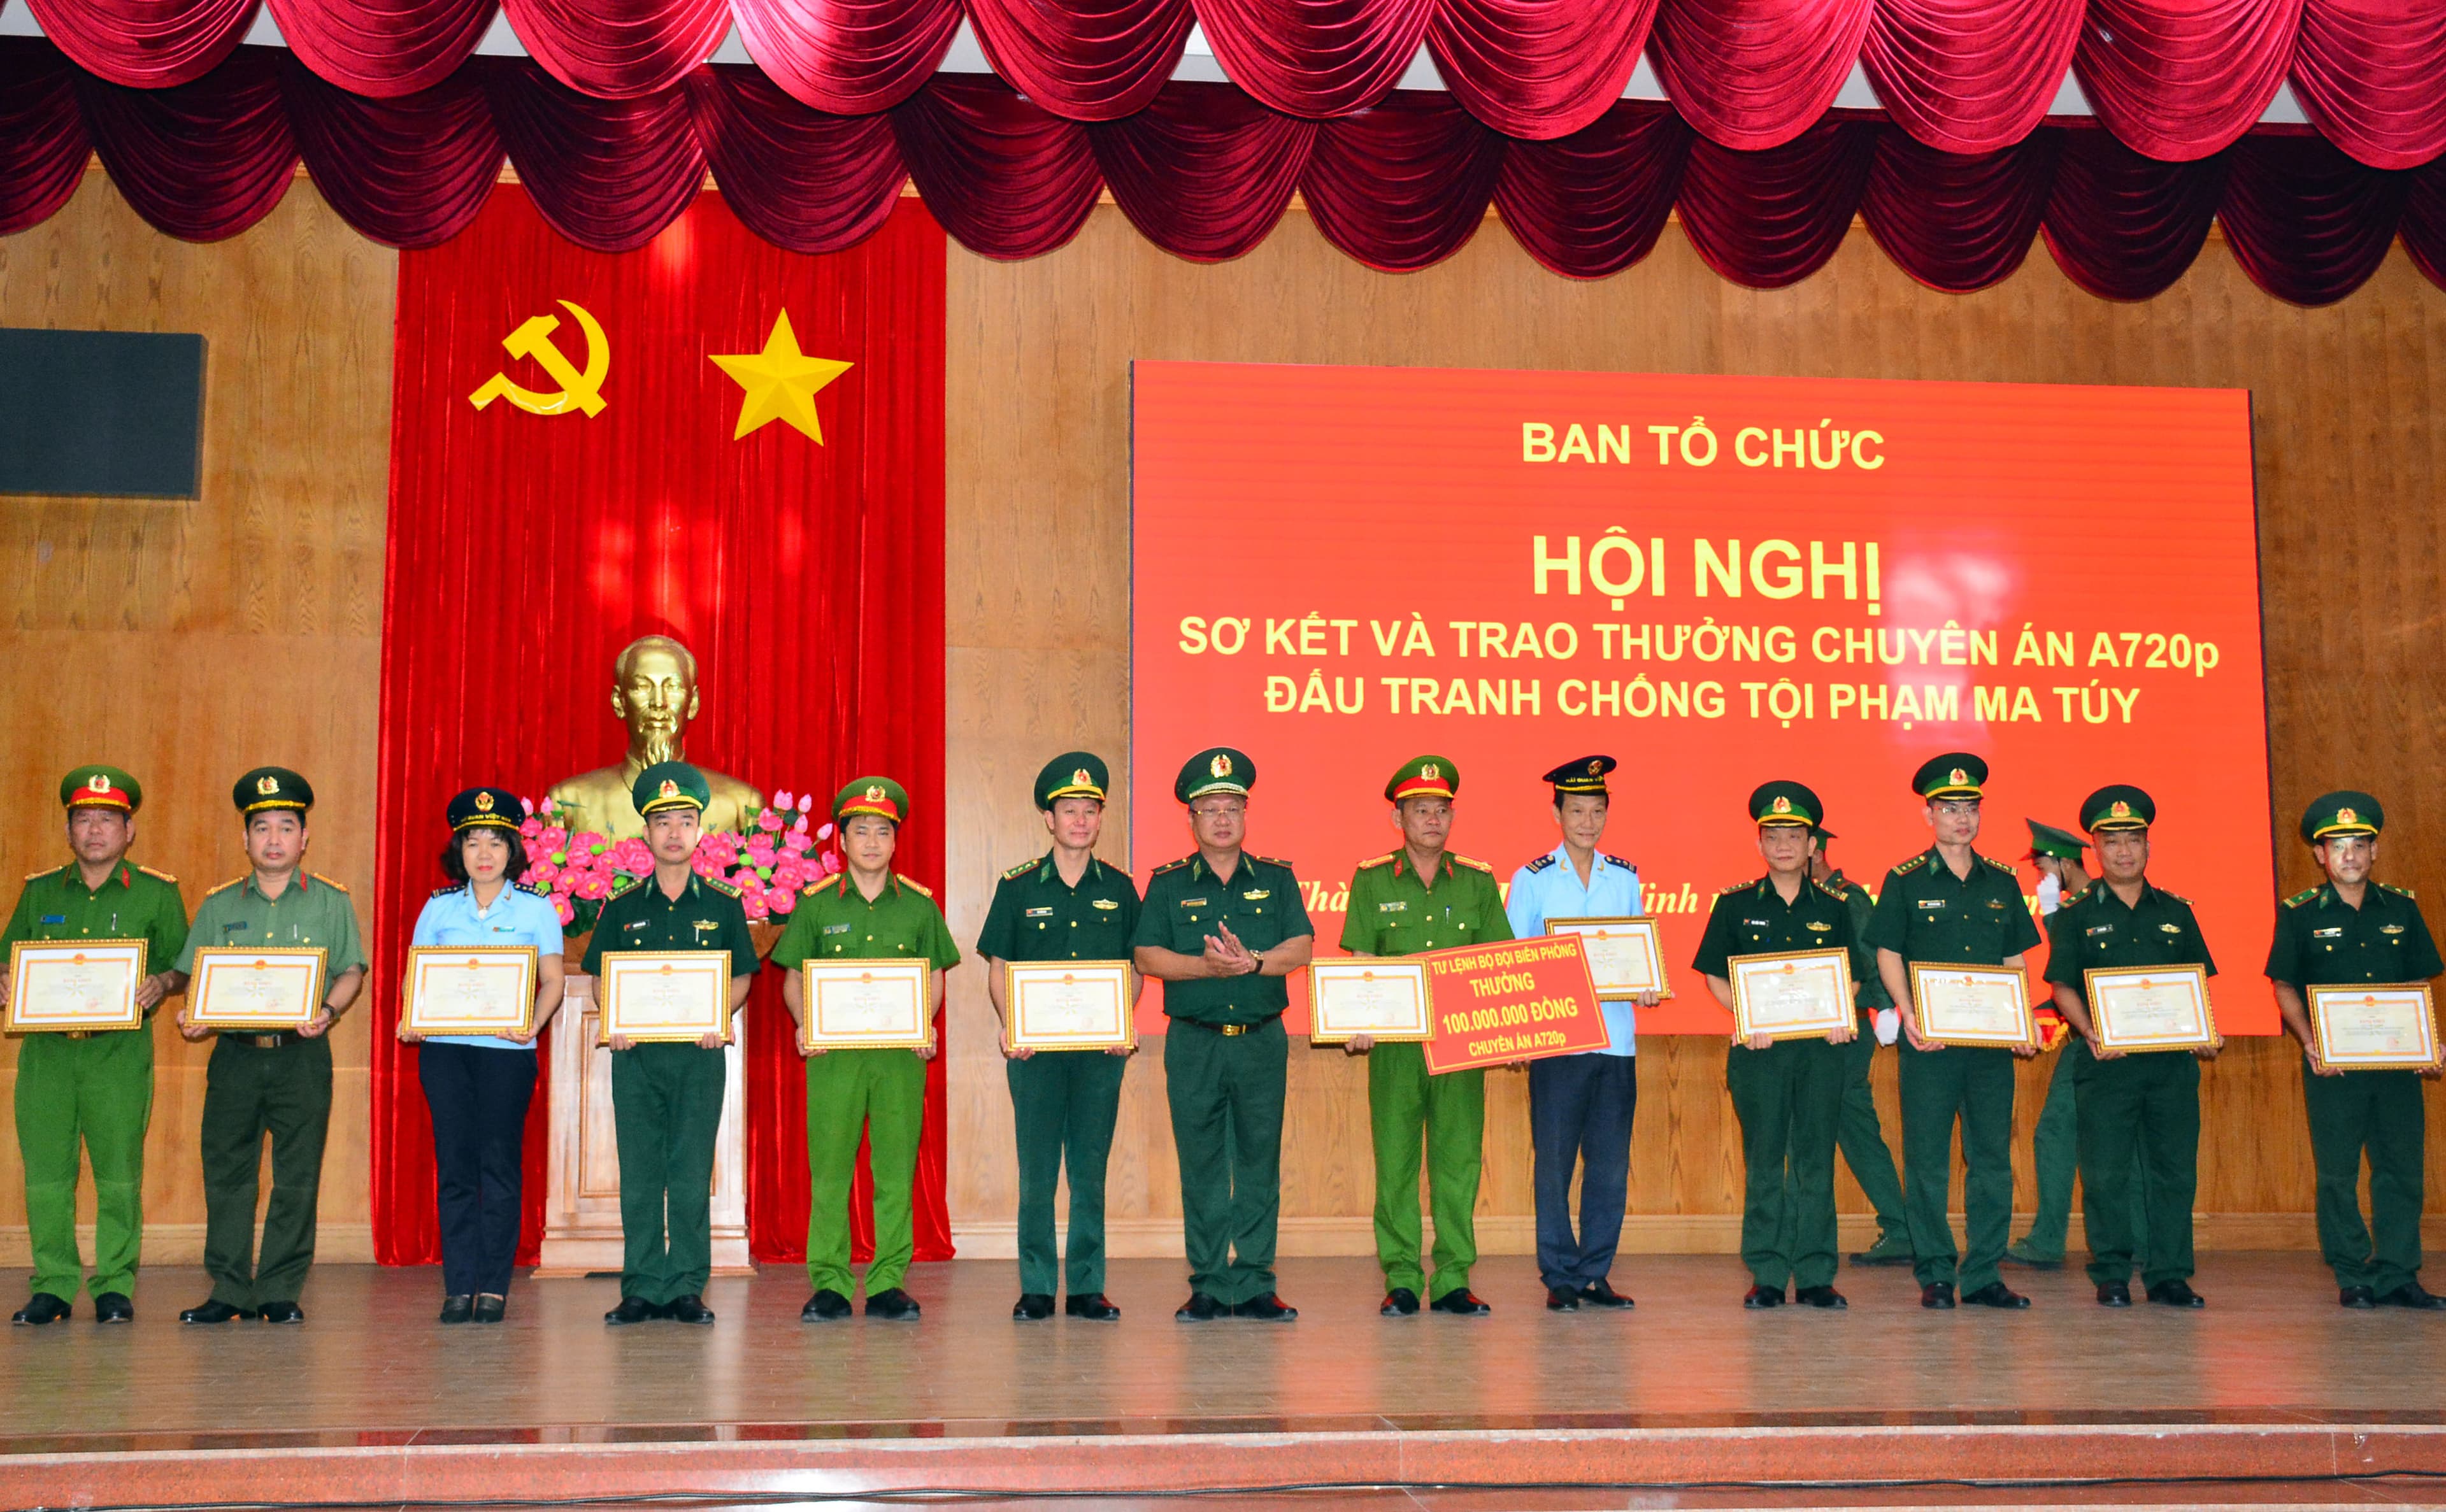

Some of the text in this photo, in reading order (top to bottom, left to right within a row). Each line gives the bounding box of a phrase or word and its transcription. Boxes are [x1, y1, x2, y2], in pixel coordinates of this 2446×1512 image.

[1522, 415, 1885, 470] BAN TỔ CHỨC
[1533, 525, 1881, 616] HỘI NGHỊ
[1179, 611, 2219, 678] SƠ KẾT VÀ TRAO THƯỞNG CHUYÊN ÁN A720p
[1263, 668, 2140, 731] ĐẤU TRANH CHỐNG TỘI PHẠM MA TÚY
[1639, 883, 1698, 913] inh
[1448, 956, 1477, 975] LỆNH
[1477, 953, 1494, 971] BỘ
[1494, 950, 1515, 969] ĐỘI
[1514, 946, 1540, 964] BIÊN
[1540, 942, 1577, 960] PHÒNG
[1469, 971, 1535, 998] THƯỞNG
[1443, 1003, 1528, 1034] 100.000.000
[1469, 1031, 1566, 1057] CHUYÊN ÁN A720p
